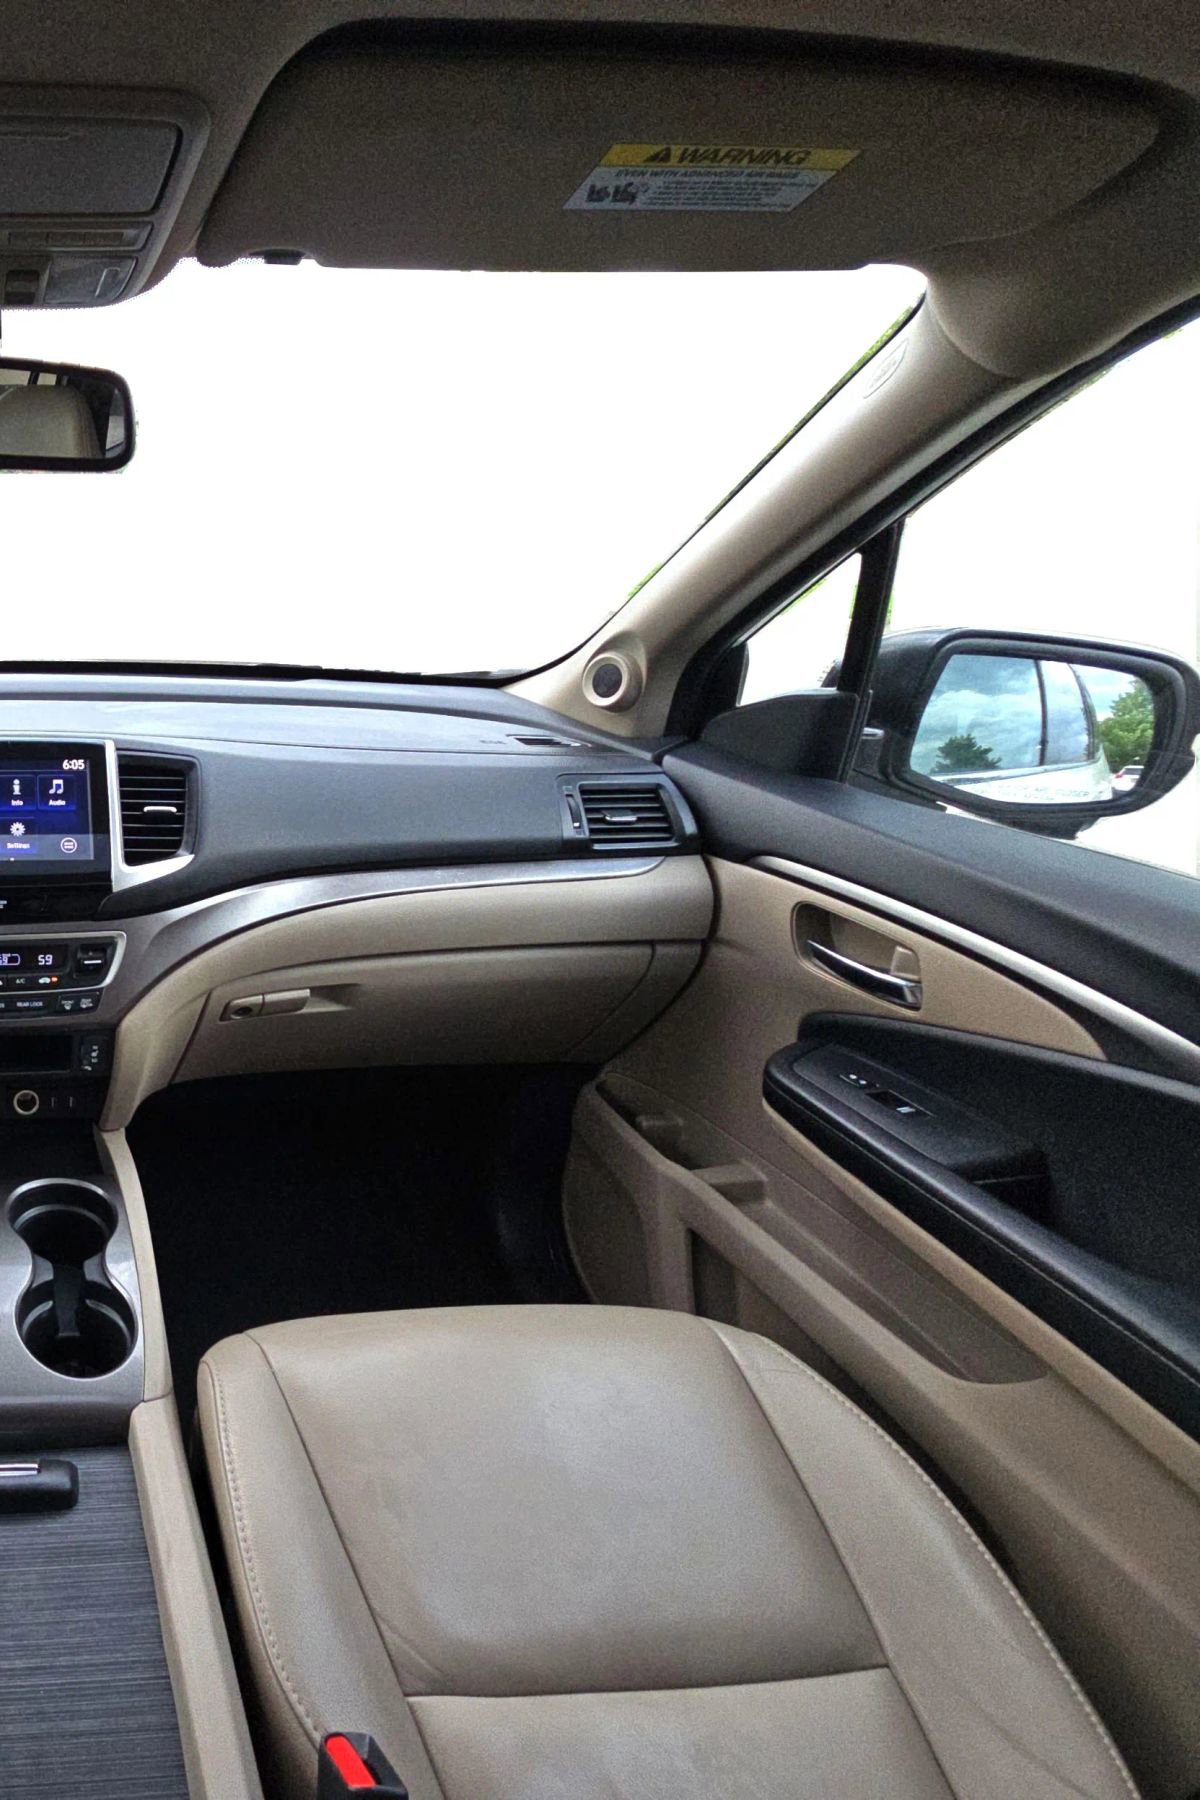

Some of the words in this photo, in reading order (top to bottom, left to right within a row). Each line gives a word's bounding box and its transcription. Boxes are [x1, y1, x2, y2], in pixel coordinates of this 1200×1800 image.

[677, 149, 812, 165] WARNING
[62, 759, 85, 771] 6:05
[11, 799, 23, 807] Info
[7, 842, 30, 850] Settings
